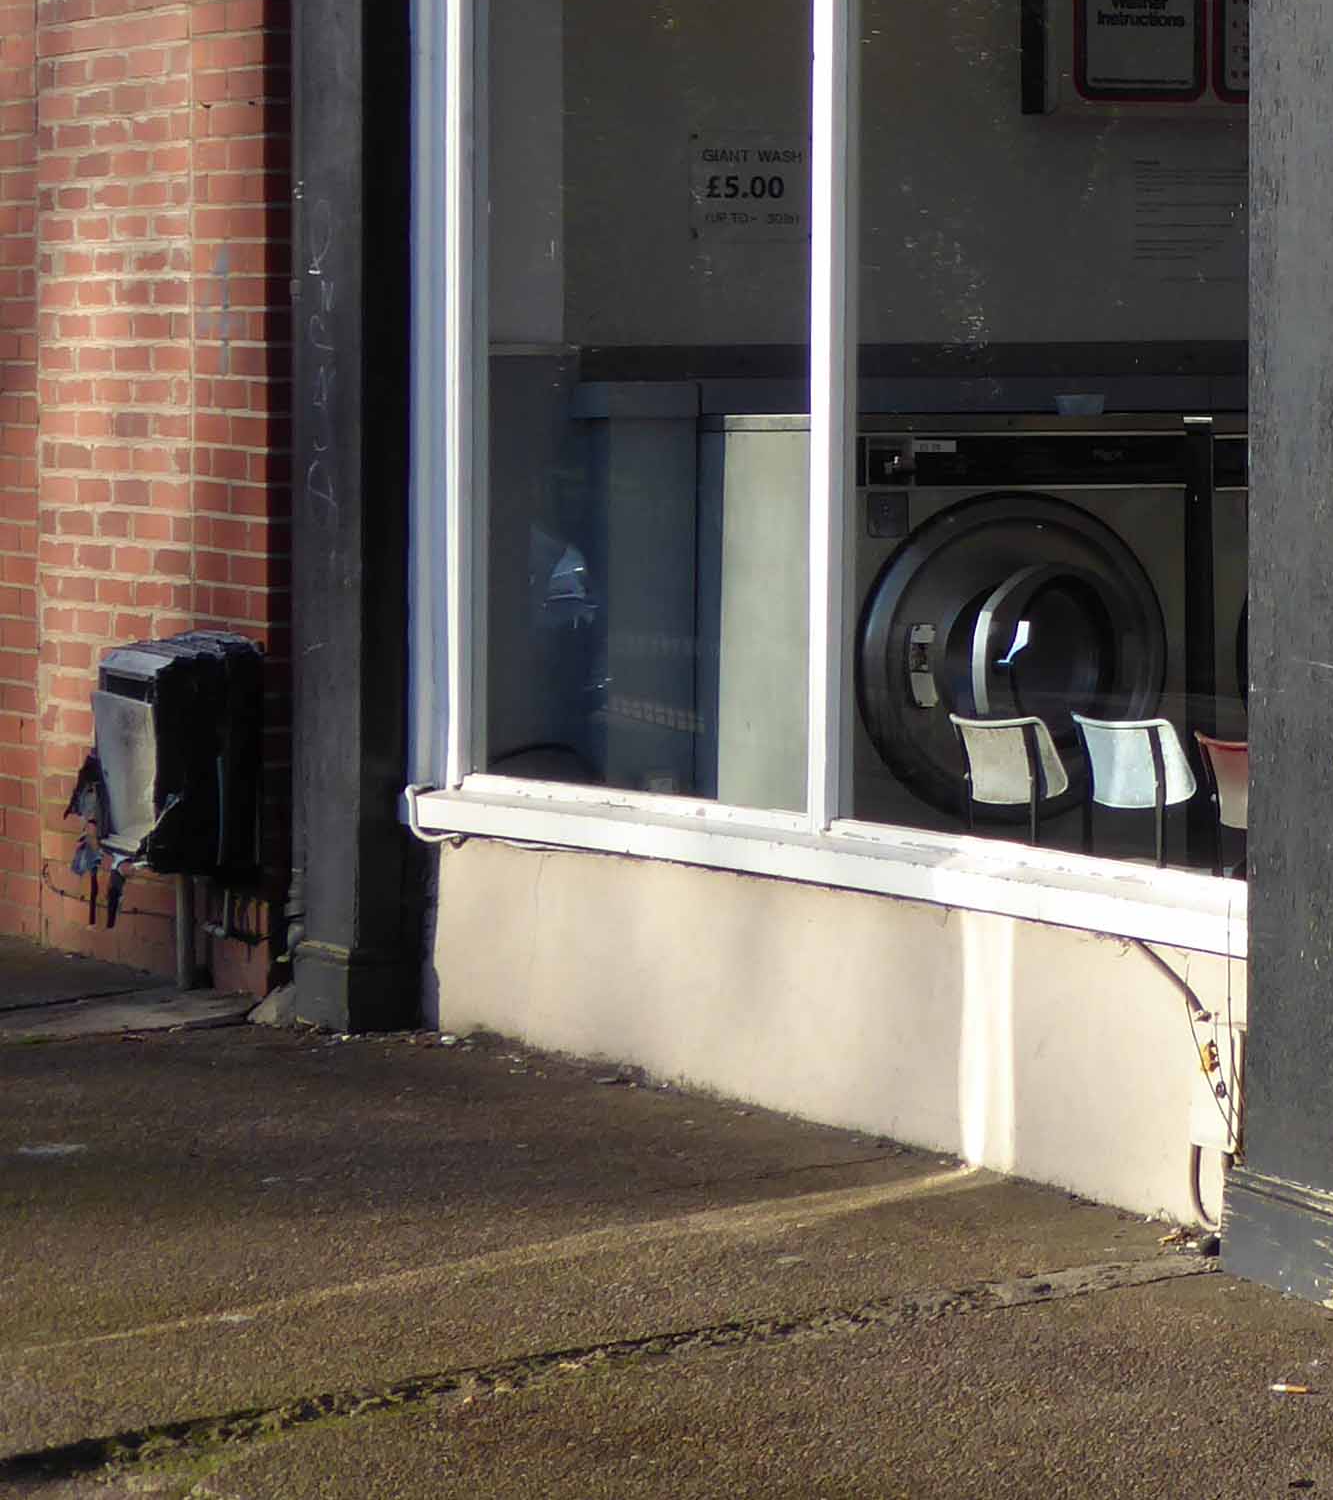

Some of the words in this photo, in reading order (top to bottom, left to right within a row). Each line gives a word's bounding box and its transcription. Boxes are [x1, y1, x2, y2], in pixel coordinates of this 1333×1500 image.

[1097, 10, 1185, 27] Instructions
[702, 148, 749, 163] GIANT
[758, 149, 802, 164] WASH
[706, 174, 785, 199] £5.00
